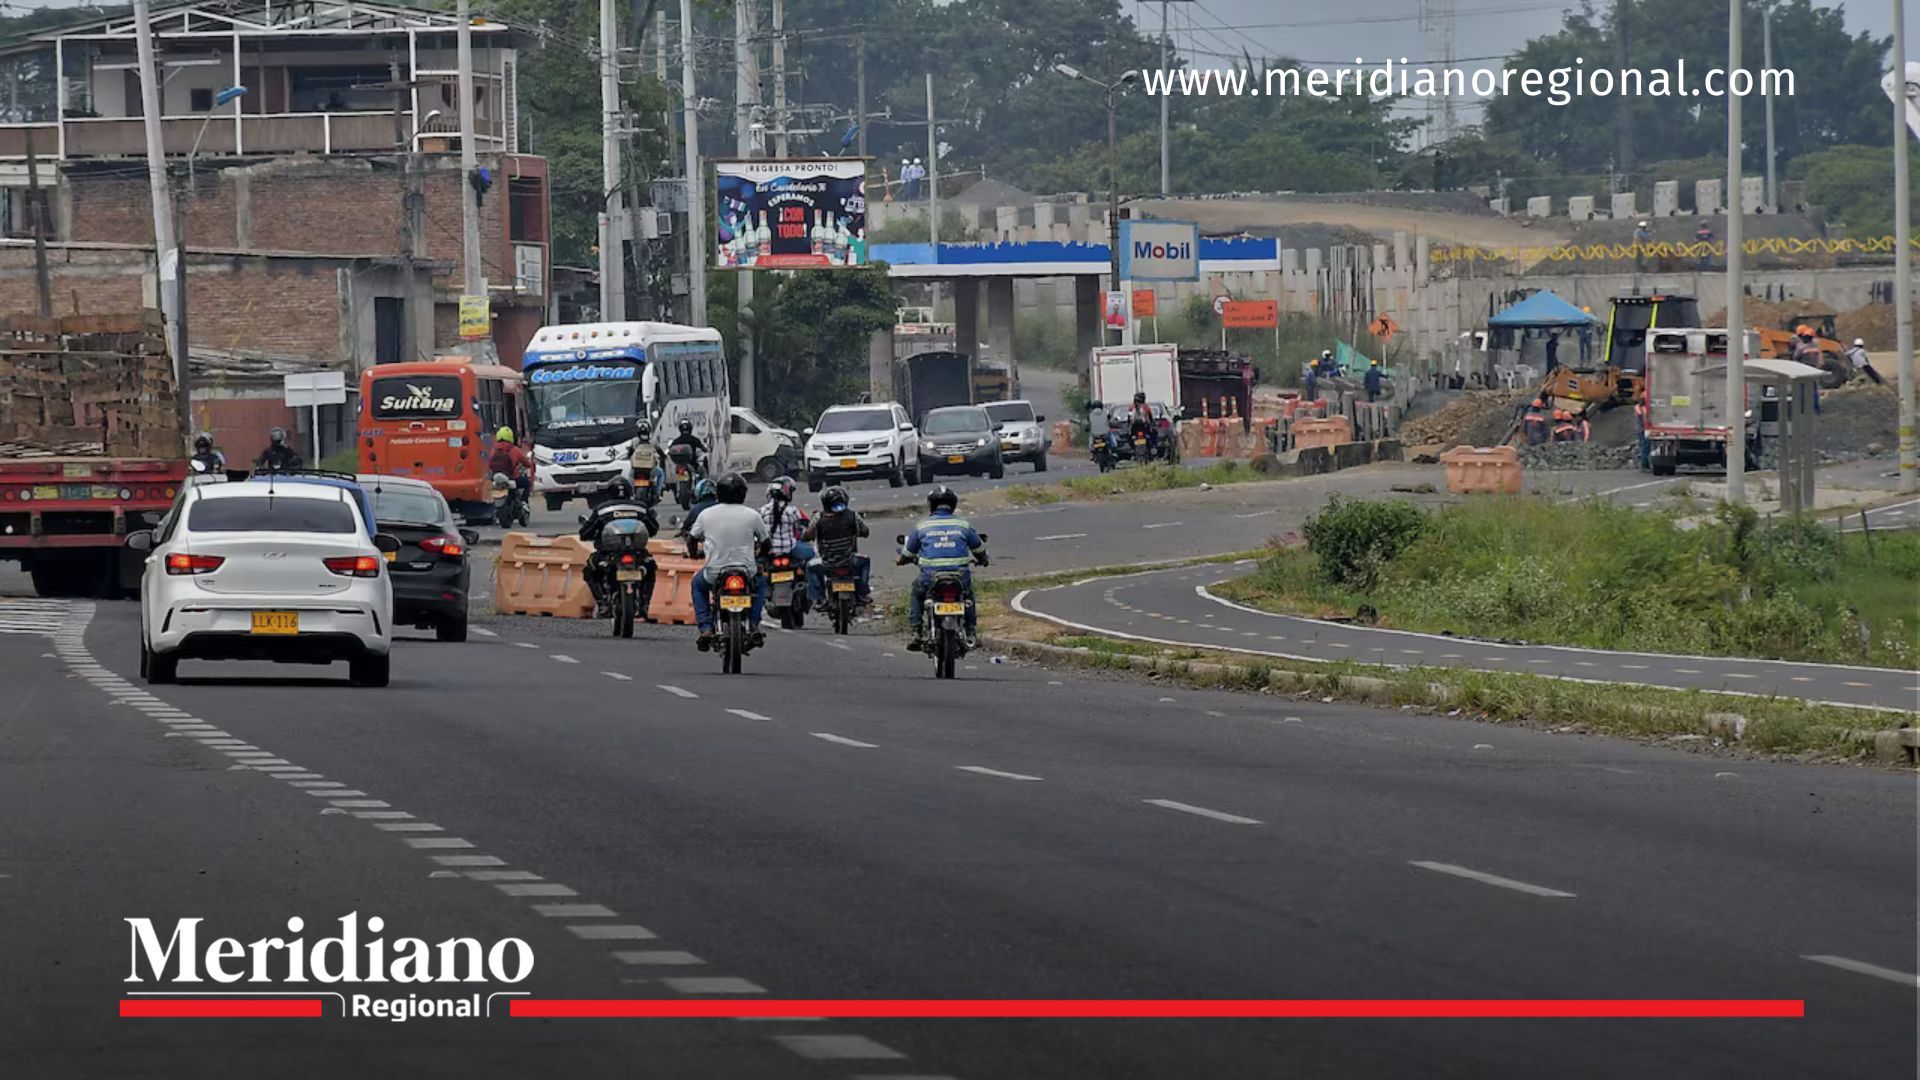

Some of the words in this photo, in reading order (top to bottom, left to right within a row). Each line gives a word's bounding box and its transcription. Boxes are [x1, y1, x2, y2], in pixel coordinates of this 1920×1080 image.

[767, 193, 815, 207] ESPERAMOS
[1134, 241, 1190, 259] Mobil
[531, 366, 635, 383] Coodetrans
[380, 396, 455, 410] Sultana
